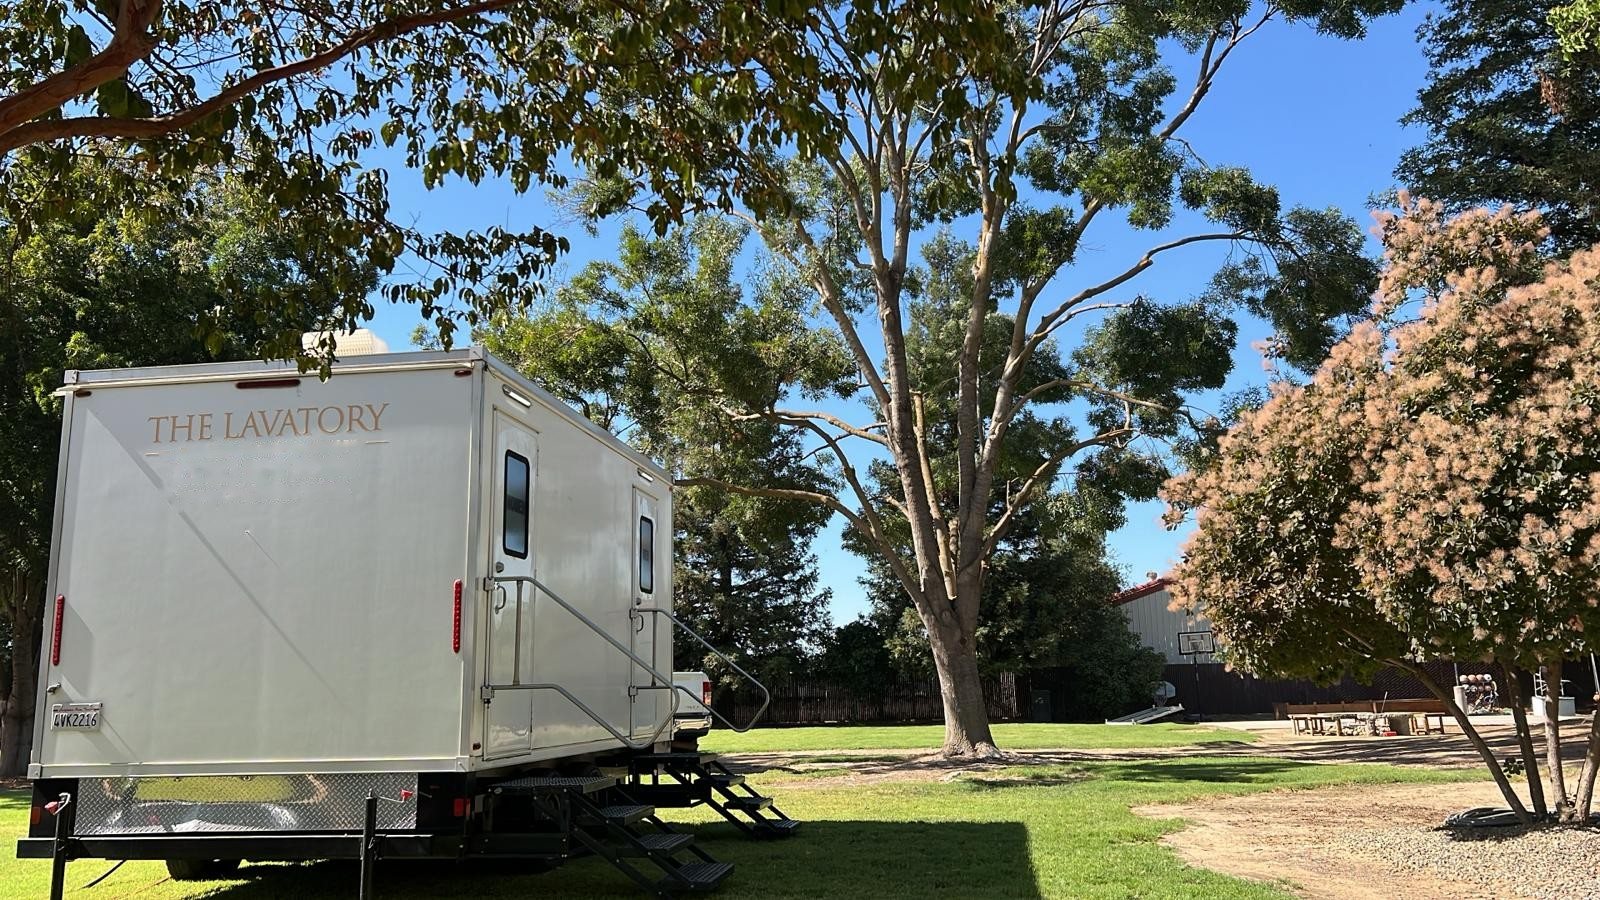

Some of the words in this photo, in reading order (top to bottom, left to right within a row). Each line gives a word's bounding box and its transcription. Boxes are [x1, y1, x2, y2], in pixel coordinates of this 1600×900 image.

[148, 413, 213, 443] THE
[223, 403, 389, 439] LAVATORY
[54, 713, 97, 727] 4VK2216
